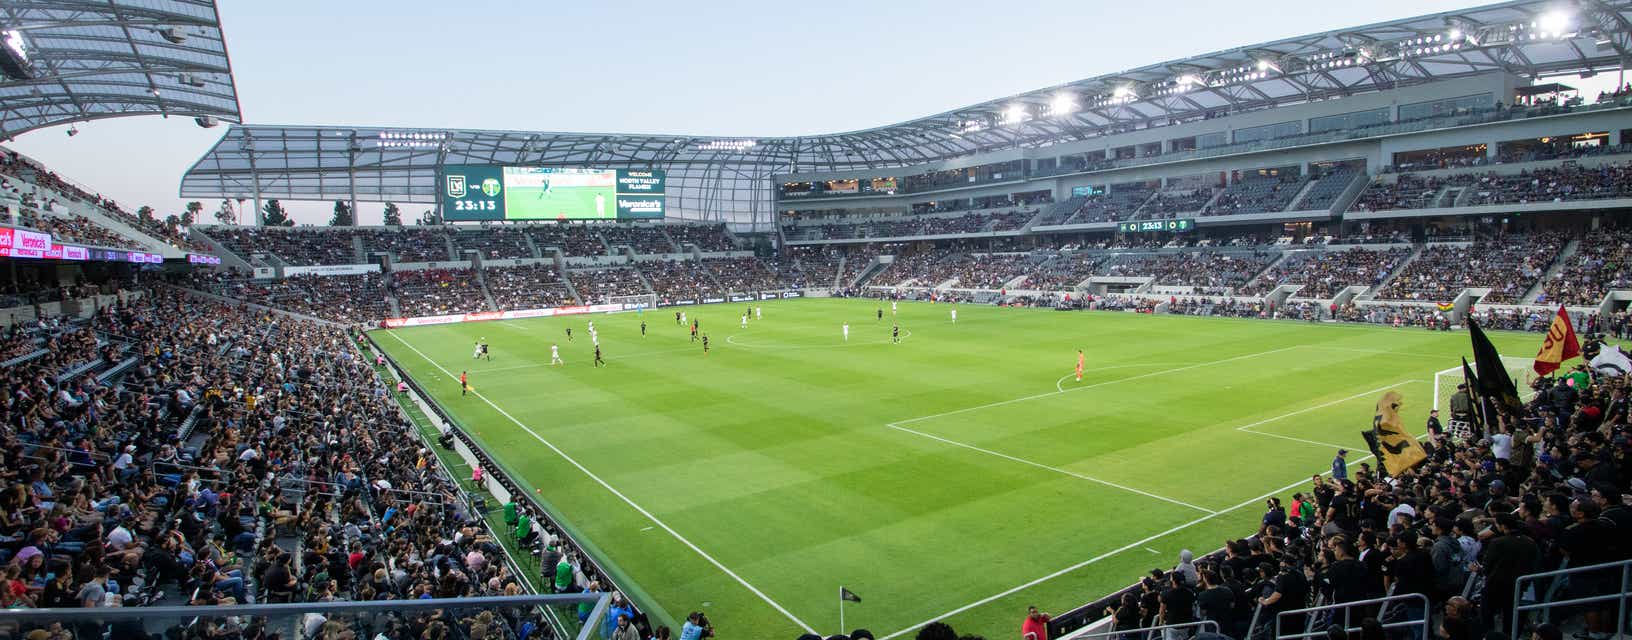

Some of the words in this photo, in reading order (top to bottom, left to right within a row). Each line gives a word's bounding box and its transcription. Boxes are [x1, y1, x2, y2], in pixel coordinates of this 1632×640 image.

[455, 200, 496, 210] 23:13
[618, 200, 661, 208] Veronica's
[1142, 222, 1163, 231] 23:13
